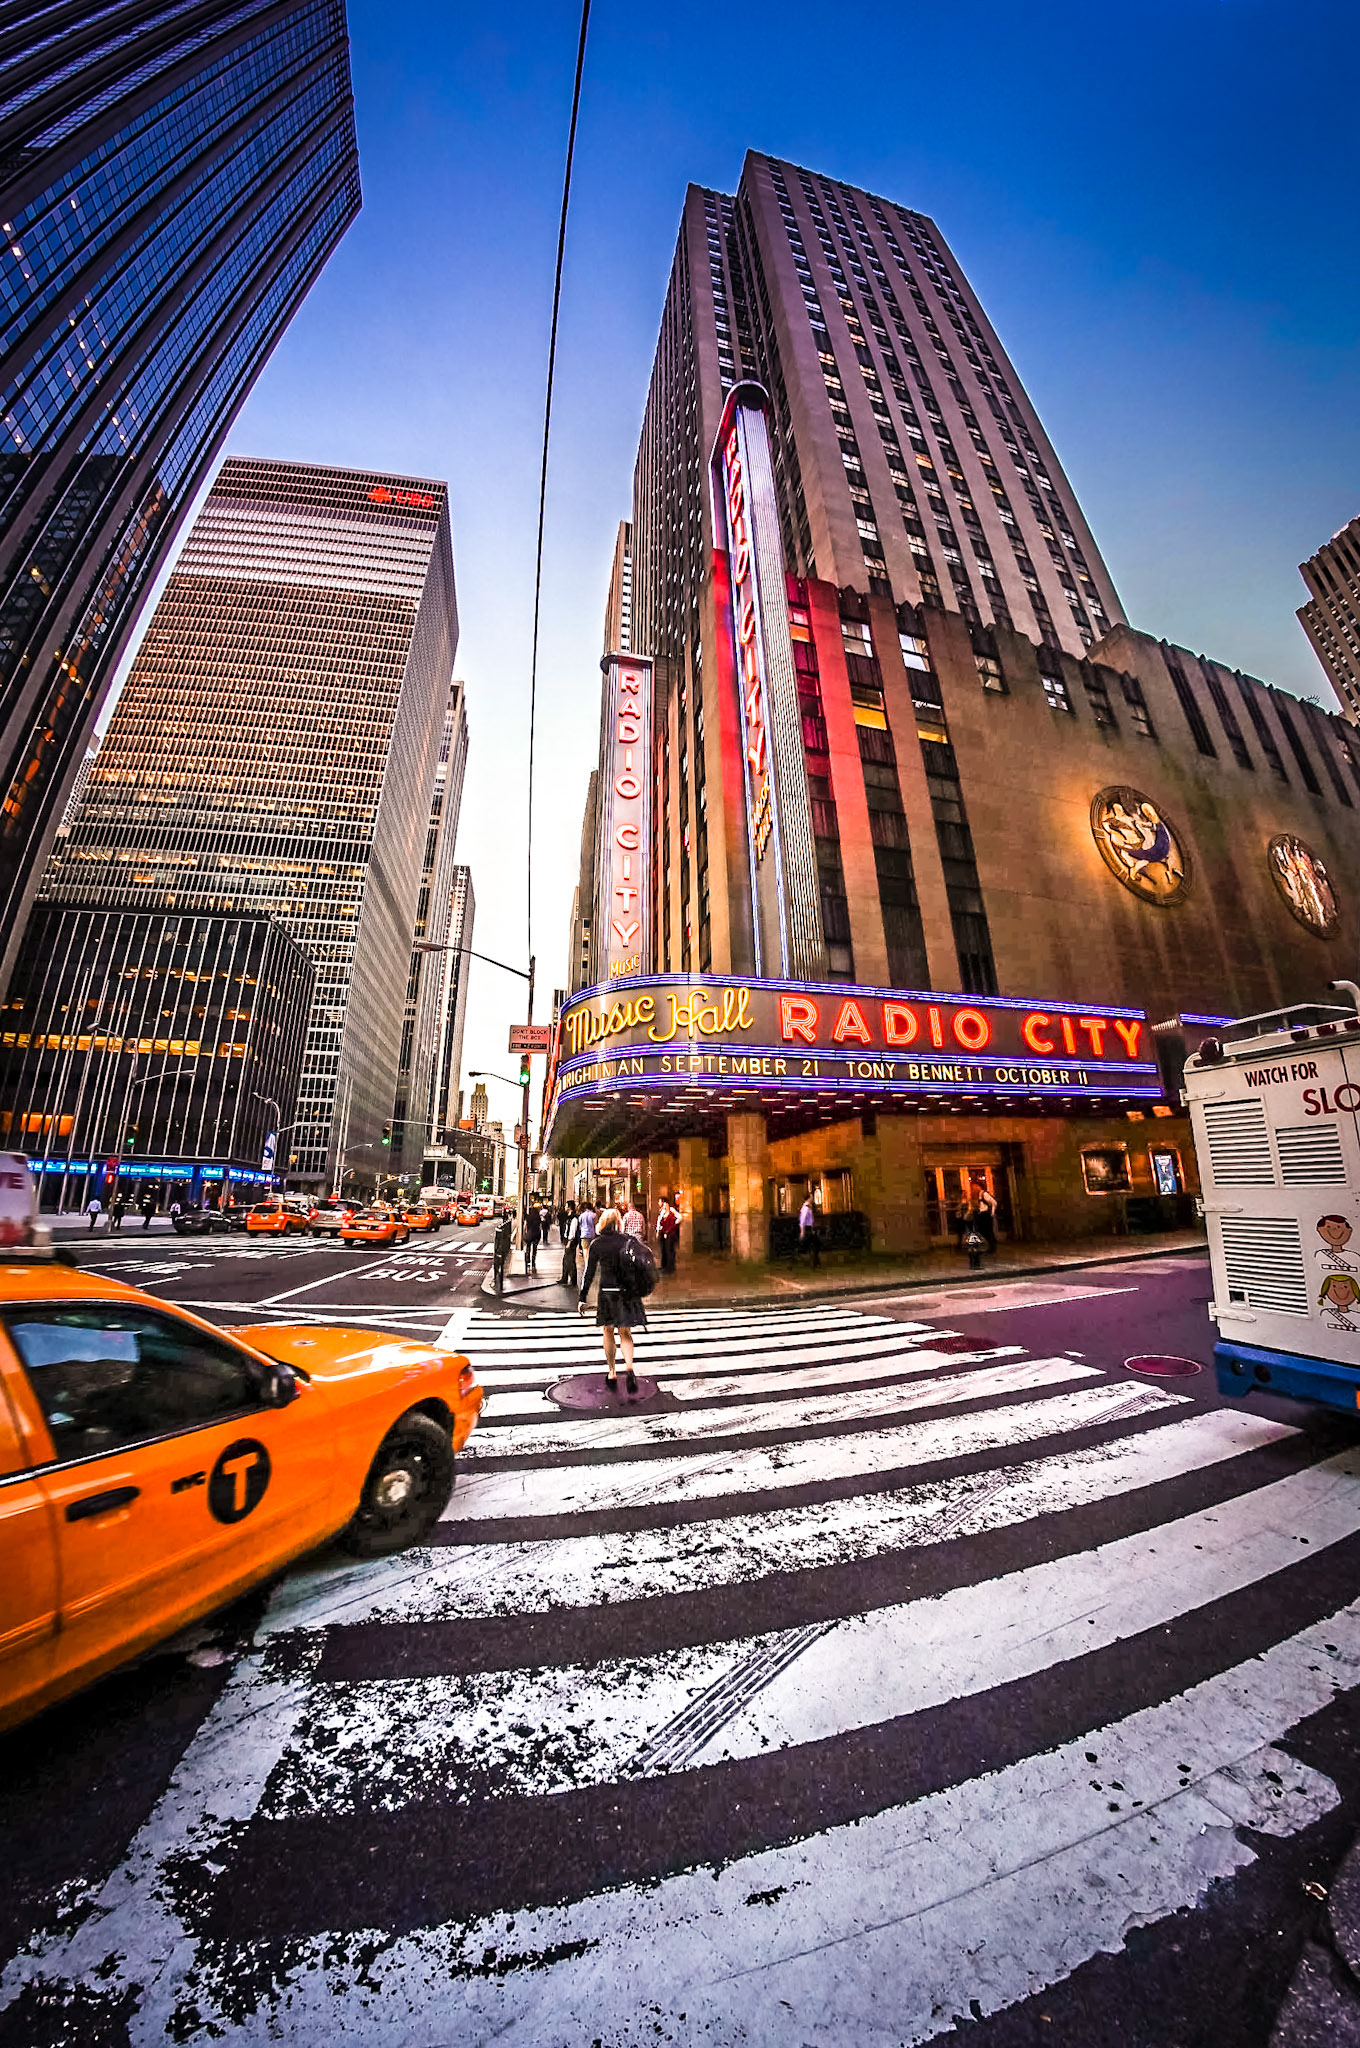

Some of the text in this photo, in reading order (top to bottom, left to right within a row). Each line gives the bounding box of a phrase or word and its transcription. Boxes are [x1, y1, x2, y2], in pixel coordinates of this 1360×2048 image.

[396, 490, 433, 508] UBS
[612, 671, 641, 947] RADIO CITY
[565, 987, 754, 1054] Music Hall
[780, 994, 1143, 1057] RADIO CITY
[660, 1055, 787, 1075] SEPTEMBER
[802, 1060, 819, 1076] 21
[845, 1061, 895, 1079] TONY
[909, 1065, 984, 1081] BENNETT
[995, 1068, 1071, 1085] OCTOBER
[1244, 1062, 1319, 1088] WATCH FOR
[358, 1268, 448, 1282] BUS
[391, 1256, 474, 1266] ONLY
